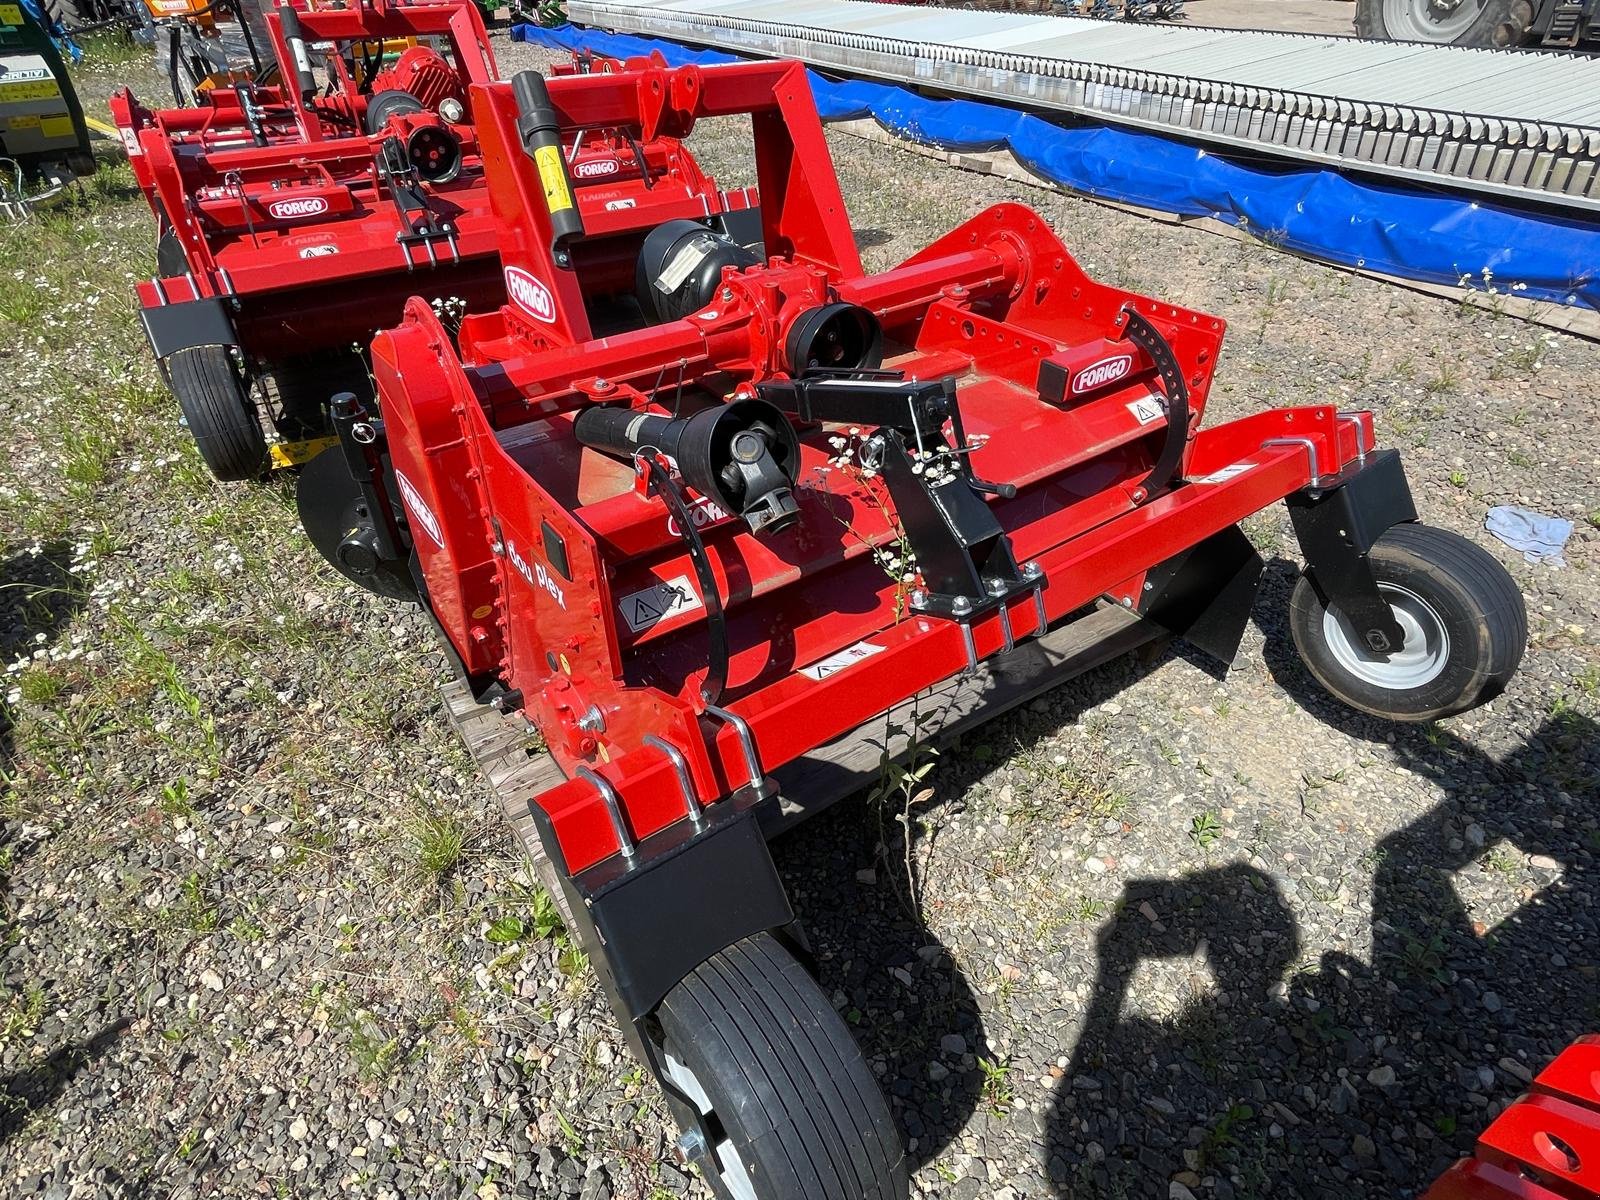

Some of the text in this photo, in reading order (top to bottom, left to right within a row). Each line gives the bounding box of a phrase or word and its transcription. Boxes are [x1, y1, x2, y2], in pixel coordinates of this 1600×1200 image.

[579, 162, 614, 176] FORIGO
[275, 200, 322, 216] FORIGO
[508, 270, 550, 317] FORIGO
[1079, 359, 1126, 390] FORIGO
